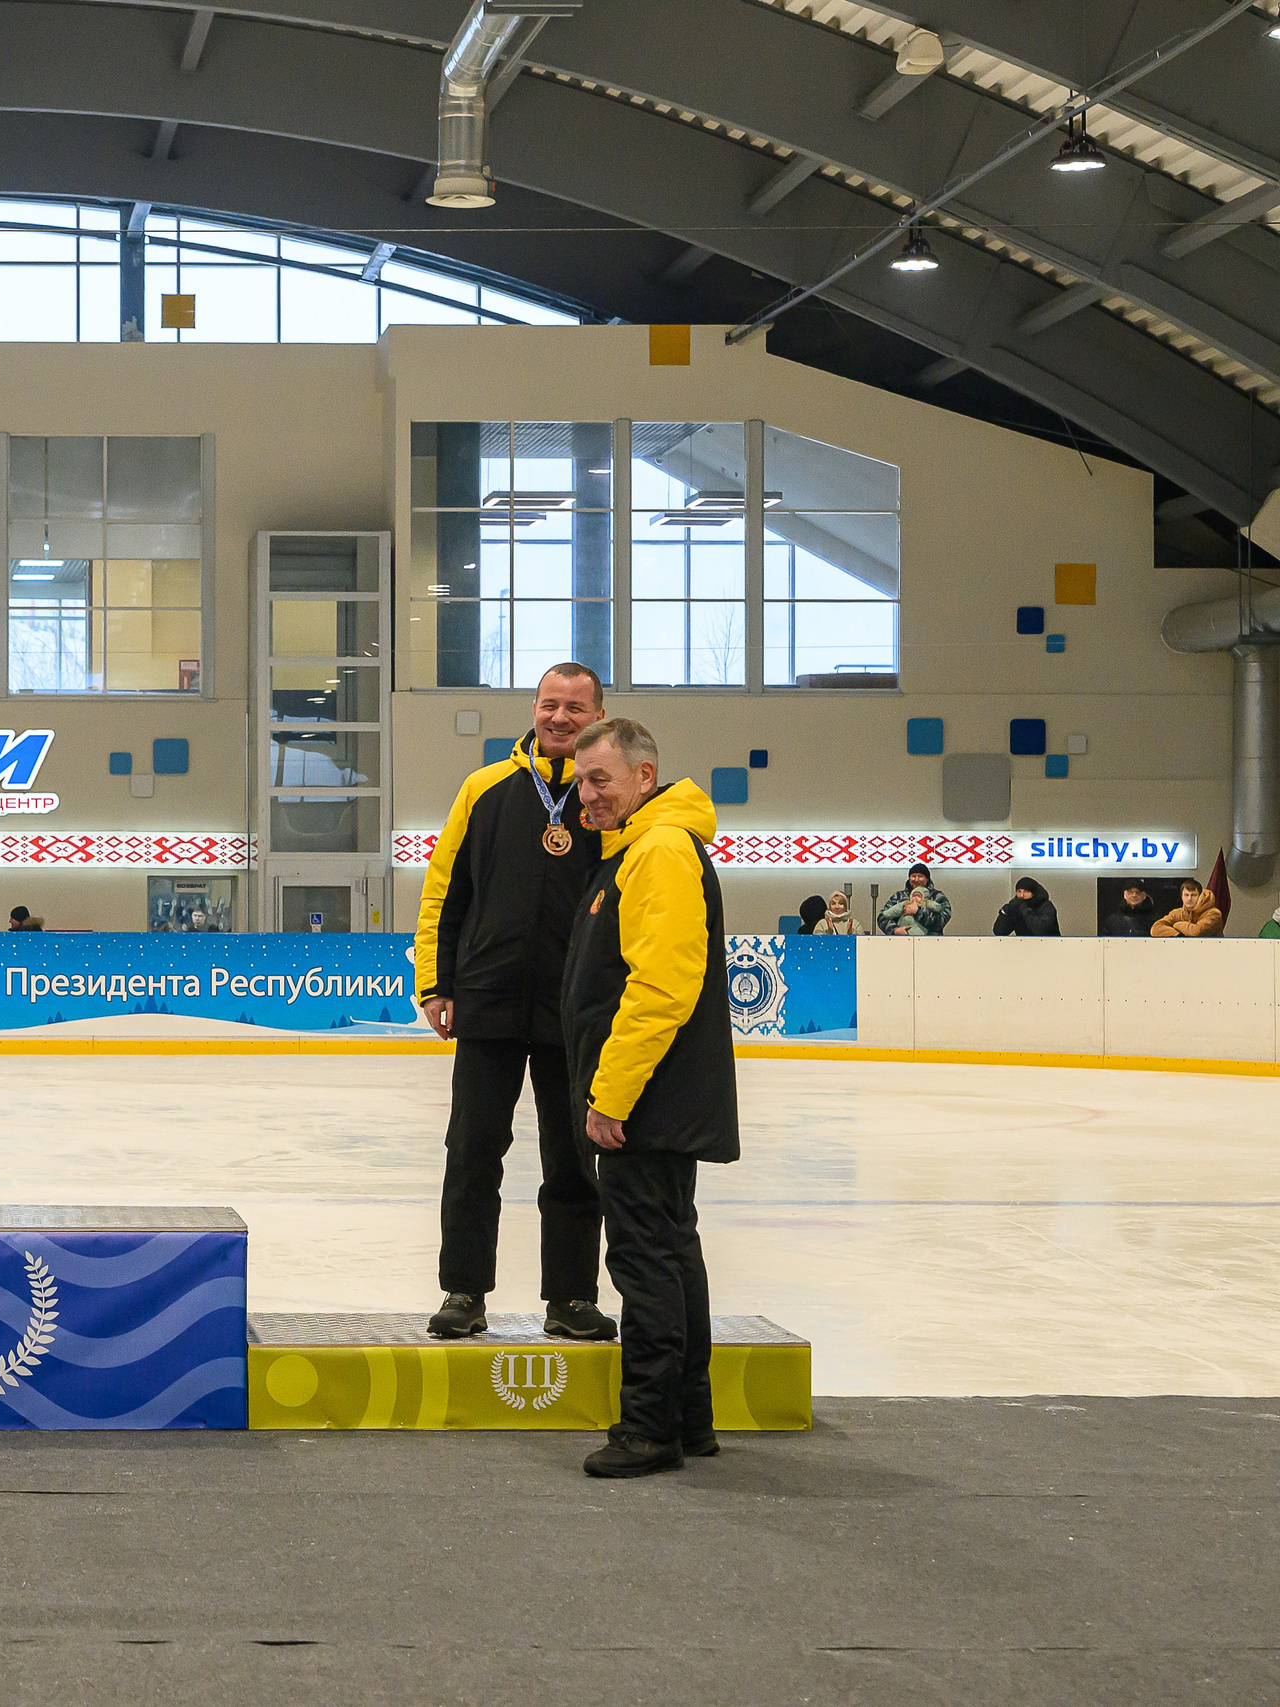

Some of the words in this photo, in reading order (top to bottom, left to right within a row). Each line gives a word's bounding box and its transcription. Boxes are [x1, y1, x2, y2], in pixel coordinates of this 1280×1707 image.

[1030, 837, 1180, 862] silichy.by
[6, 966, 200, 1003] Президента
[210, 966, 404, 1005] Республики
[503, 1354, 556, 1388] III
